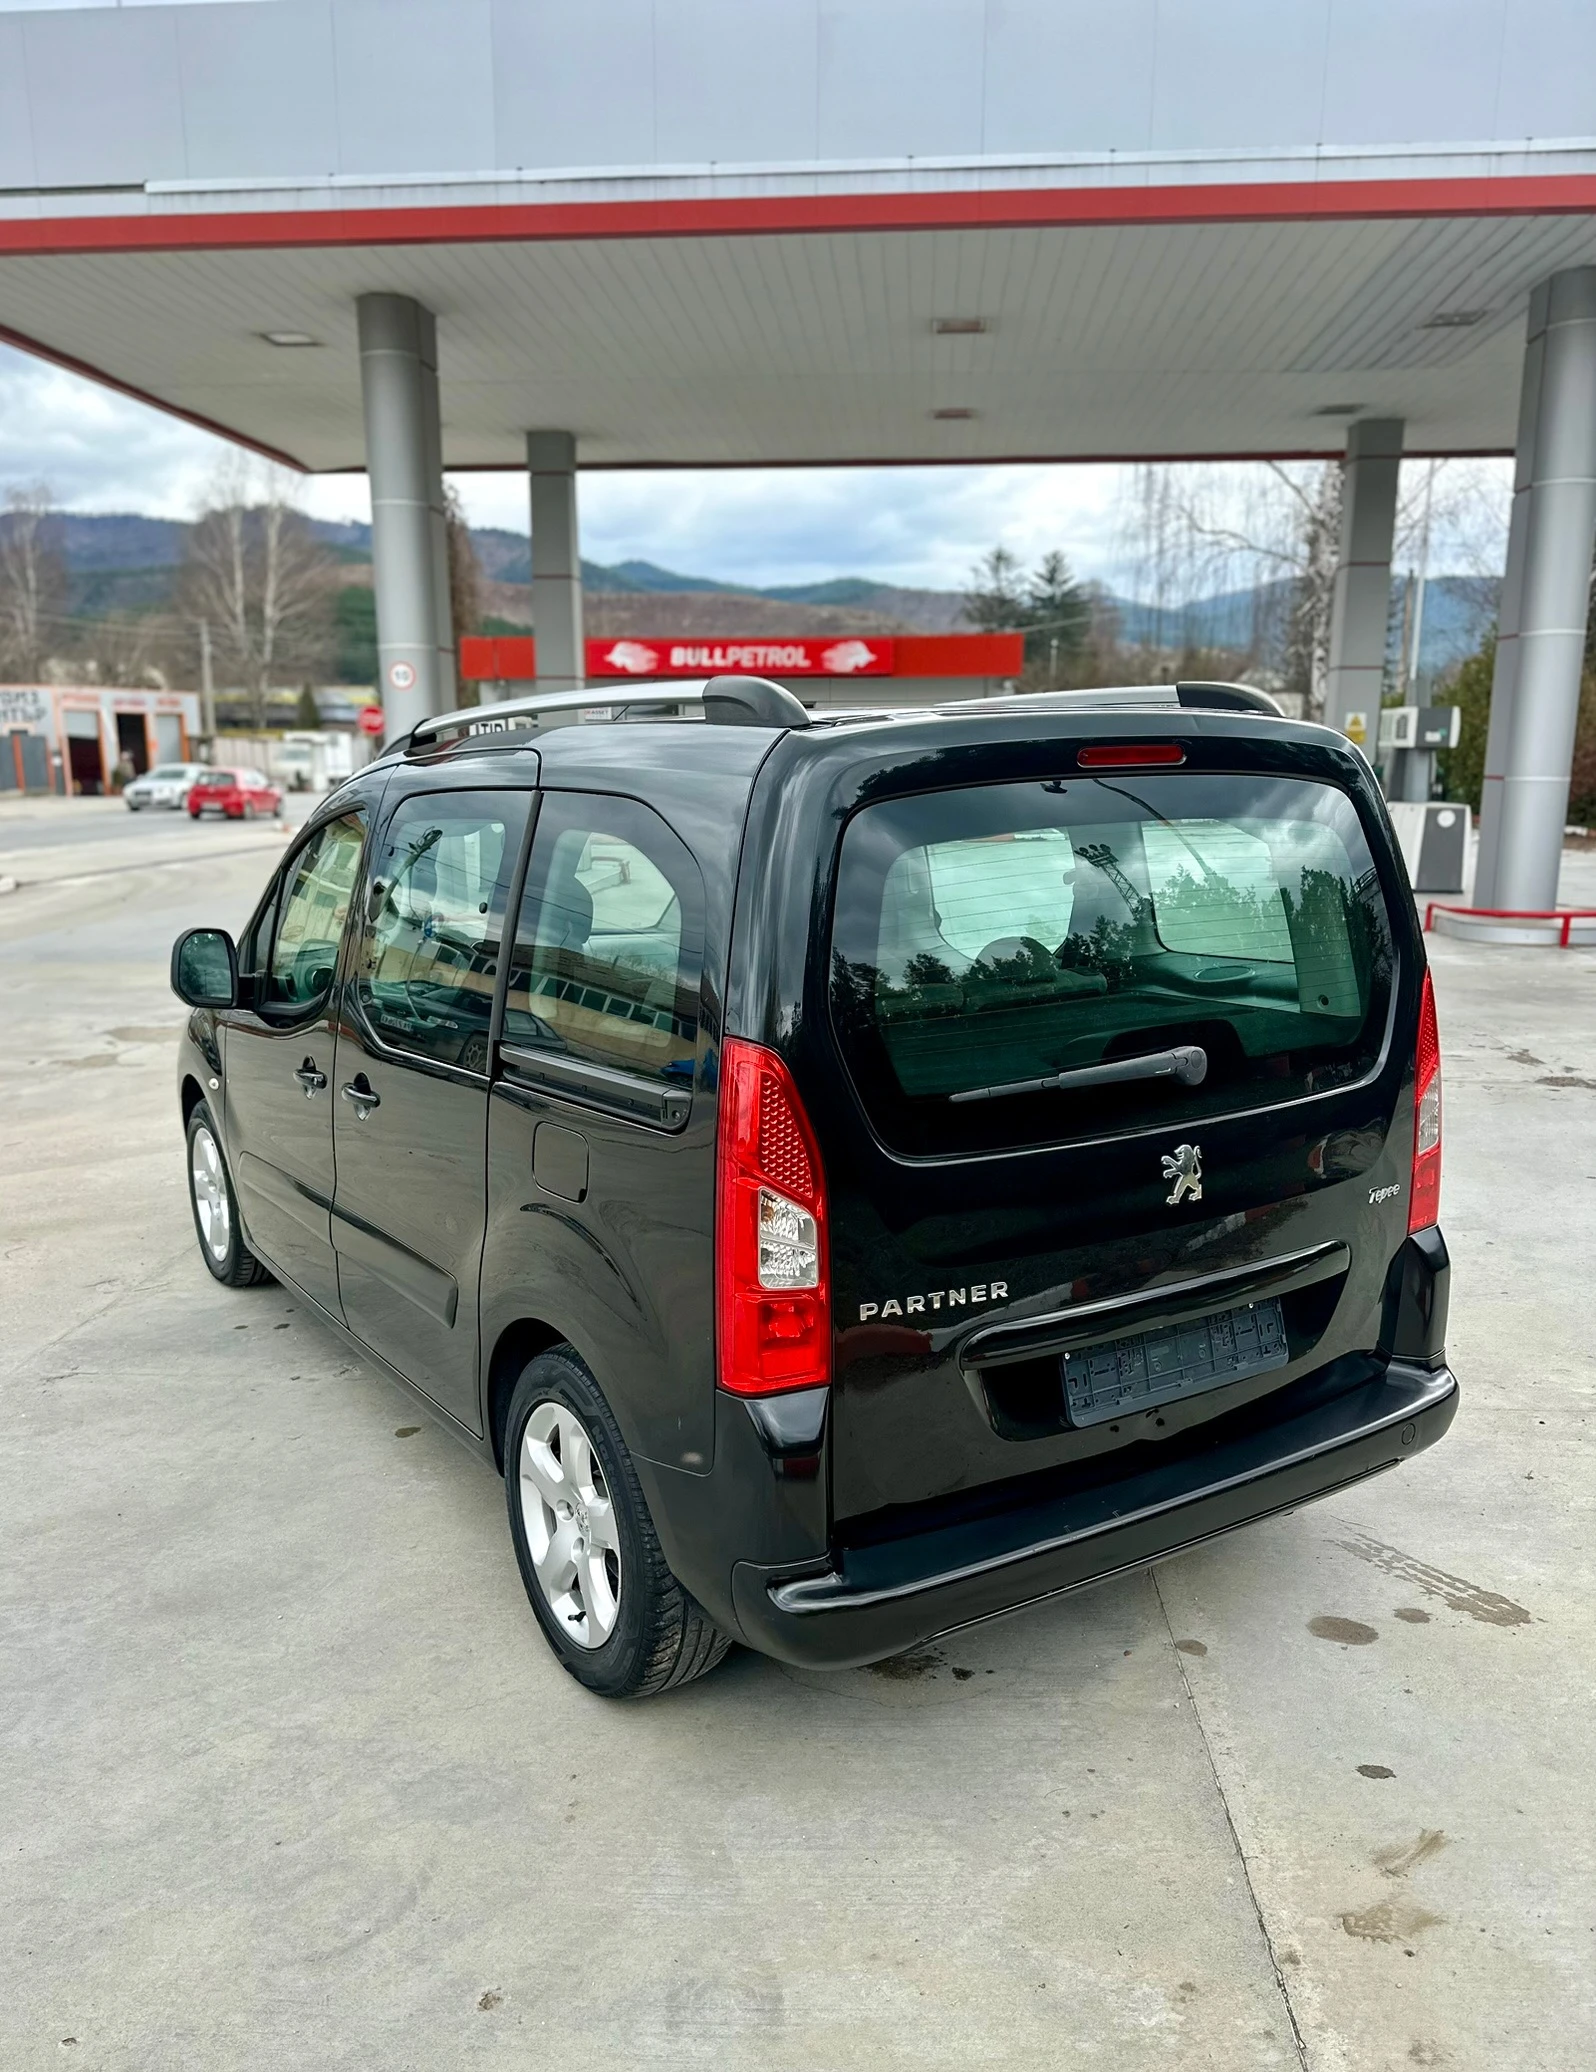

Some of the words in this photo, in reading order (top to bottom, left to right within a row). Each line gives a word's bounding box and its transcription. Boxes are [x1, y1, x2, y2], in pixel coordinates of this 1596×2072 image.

[670, 646, 812, 668] BULLPETROL
[1368, 1183, 1401, 1204] Tepee
[859, 1281, 1009, 1321] PARTNER
